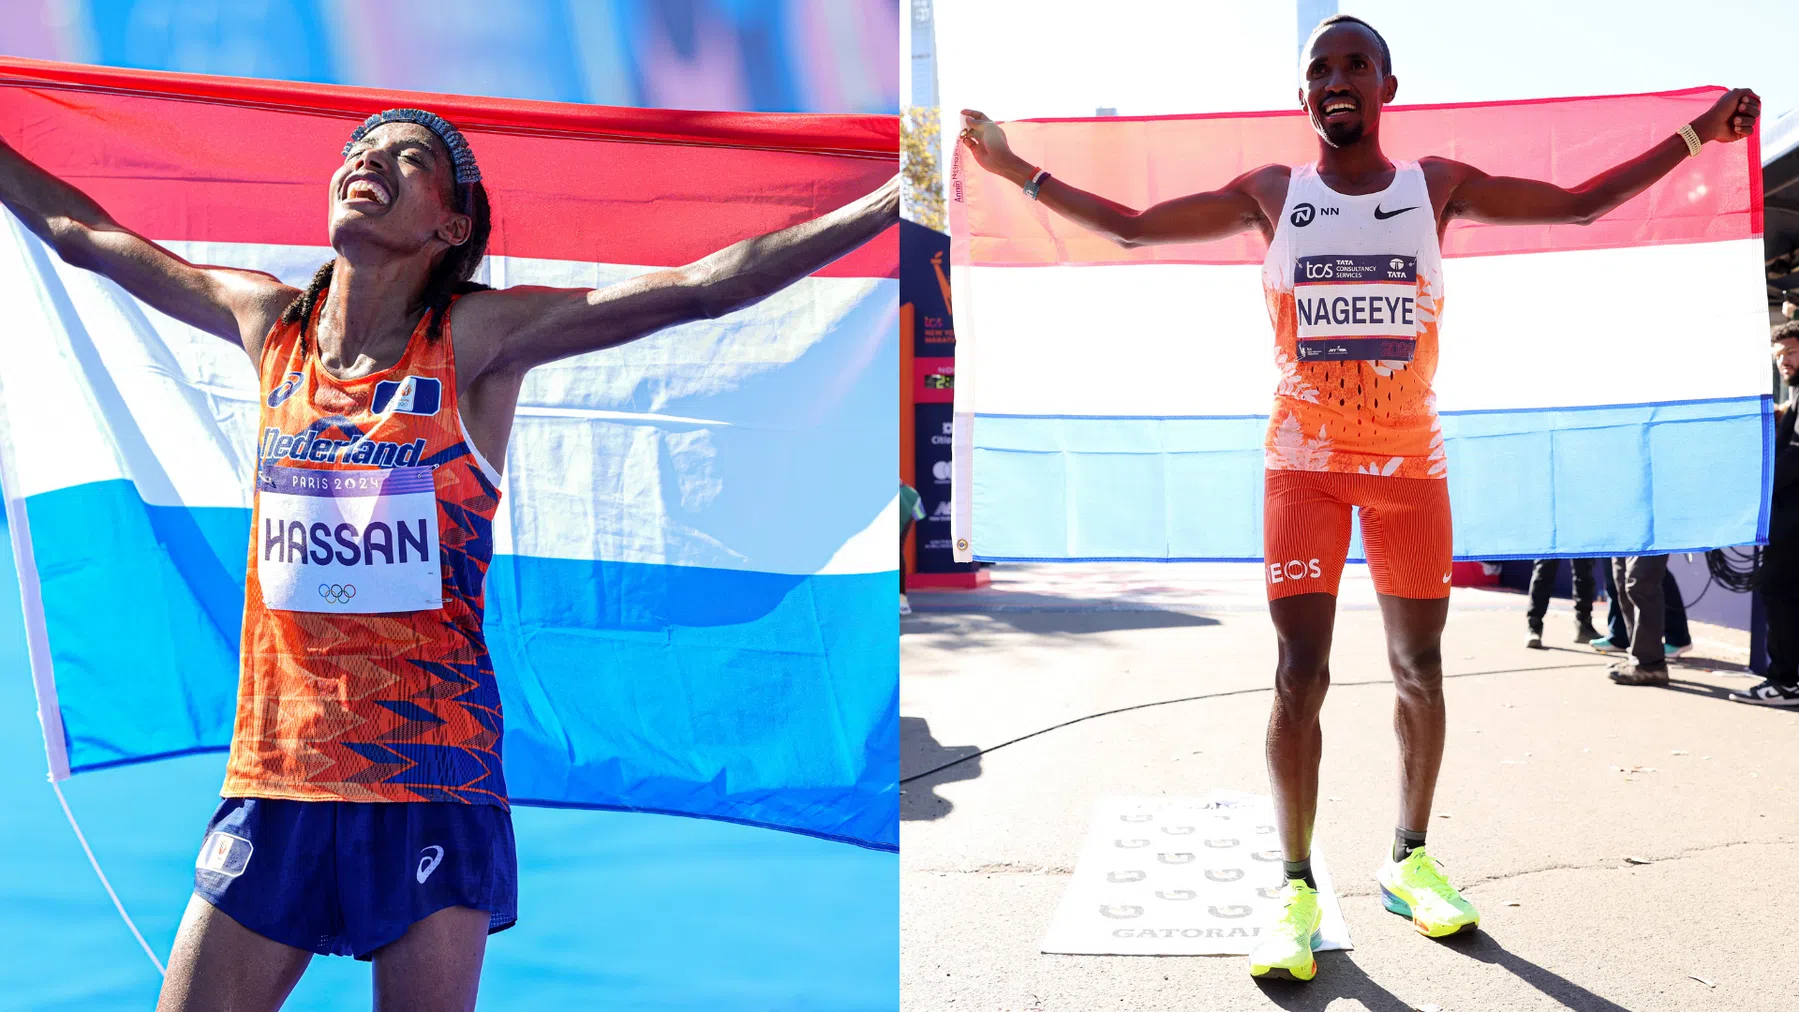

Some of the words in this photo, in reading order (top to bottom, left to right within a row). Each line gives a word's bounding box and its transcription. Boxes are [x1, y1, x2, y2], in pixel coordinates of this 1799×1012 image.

[1320, 207, 1340, 216] NN
[1306, 260, 1333, 279] tcs
[1387, 271, 1407, 279] TATA
[1297, 296, 1414, 326] NAGEEYE
[292, 475, 328, 490] PARIS
[334, 476, 379, 490] 2024
[264, 518, 429, 567] HASSAN
